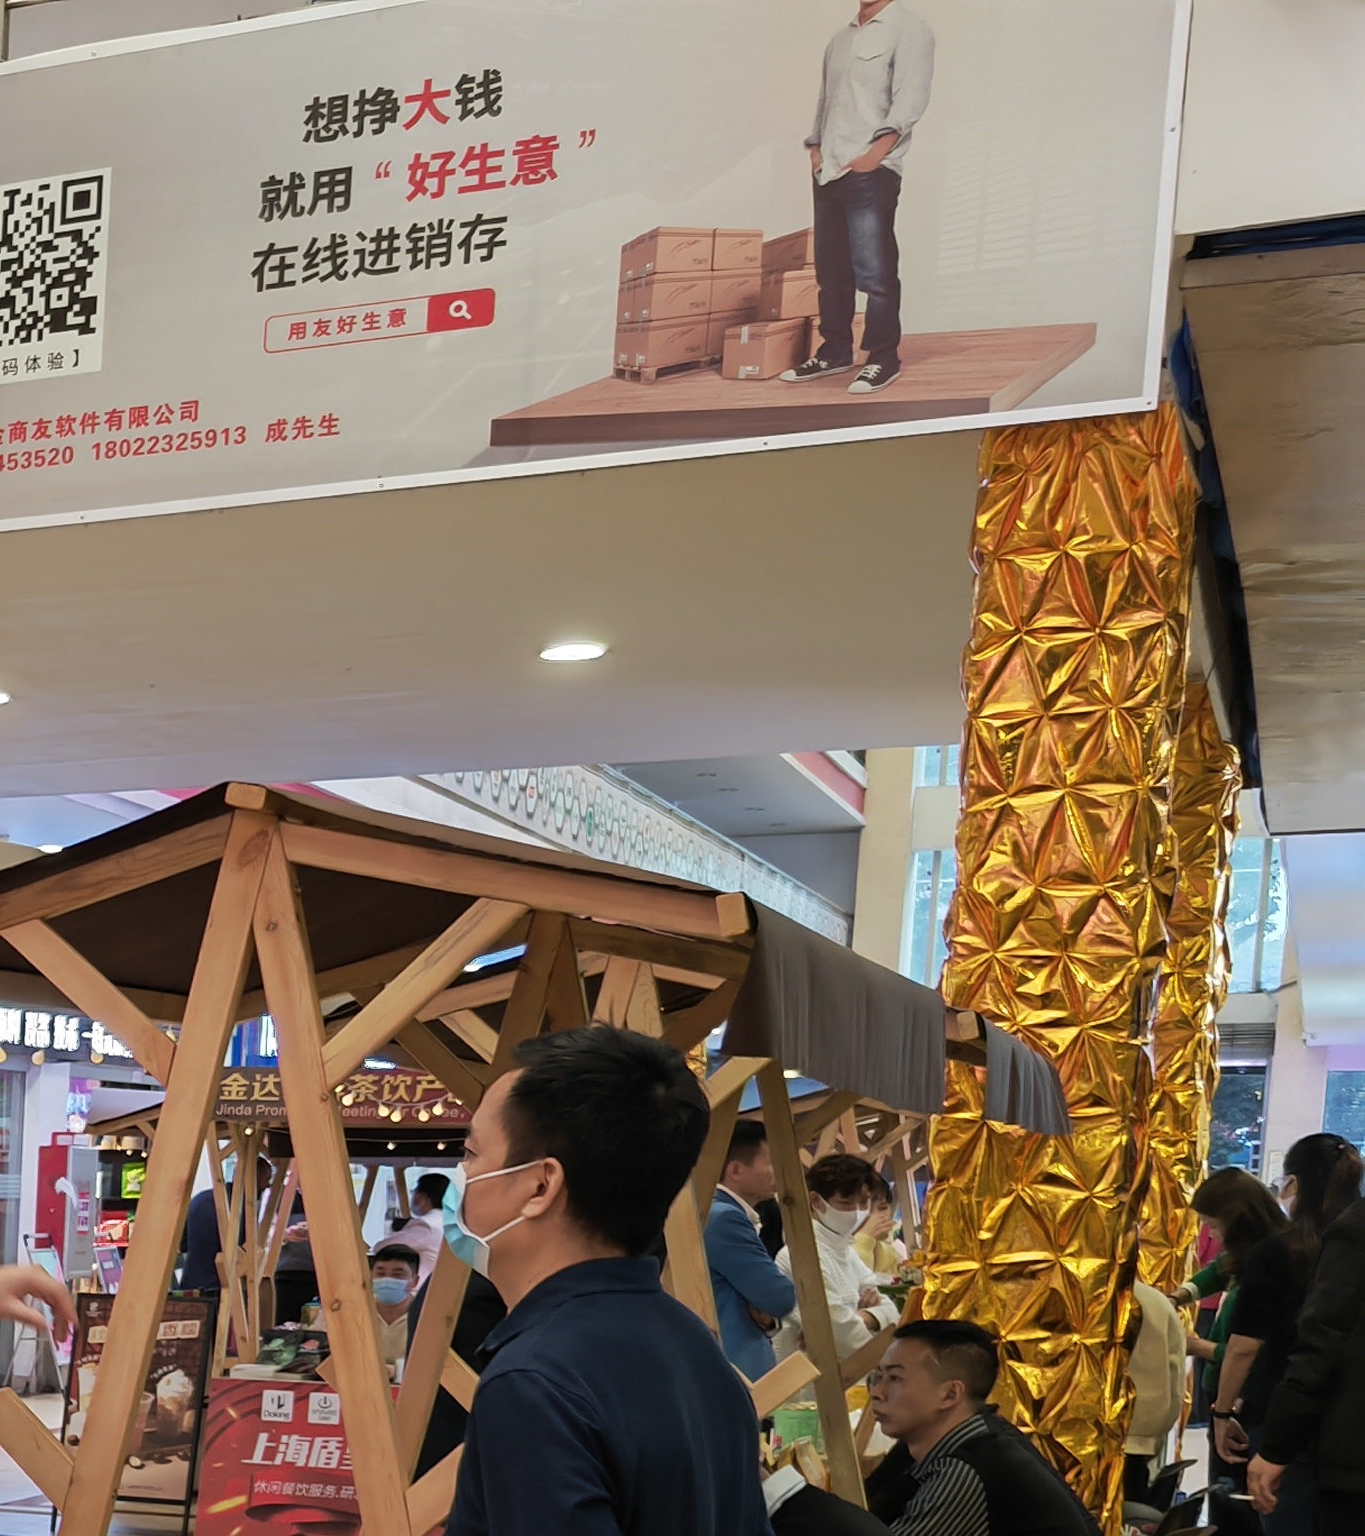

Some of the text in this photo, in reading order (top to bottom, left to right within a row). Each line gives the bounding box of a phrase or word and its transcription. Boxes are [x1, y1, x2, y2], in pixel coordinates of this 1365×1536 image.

[303, 69, 503, 143] 想挣大钱
[251, 212, 508, 293] 在线进销存
[288, 307, 407, 342] 用友好生意
[92, 425, 247, 462] 18022325913
[265, 413, 340, 443] 成先生
